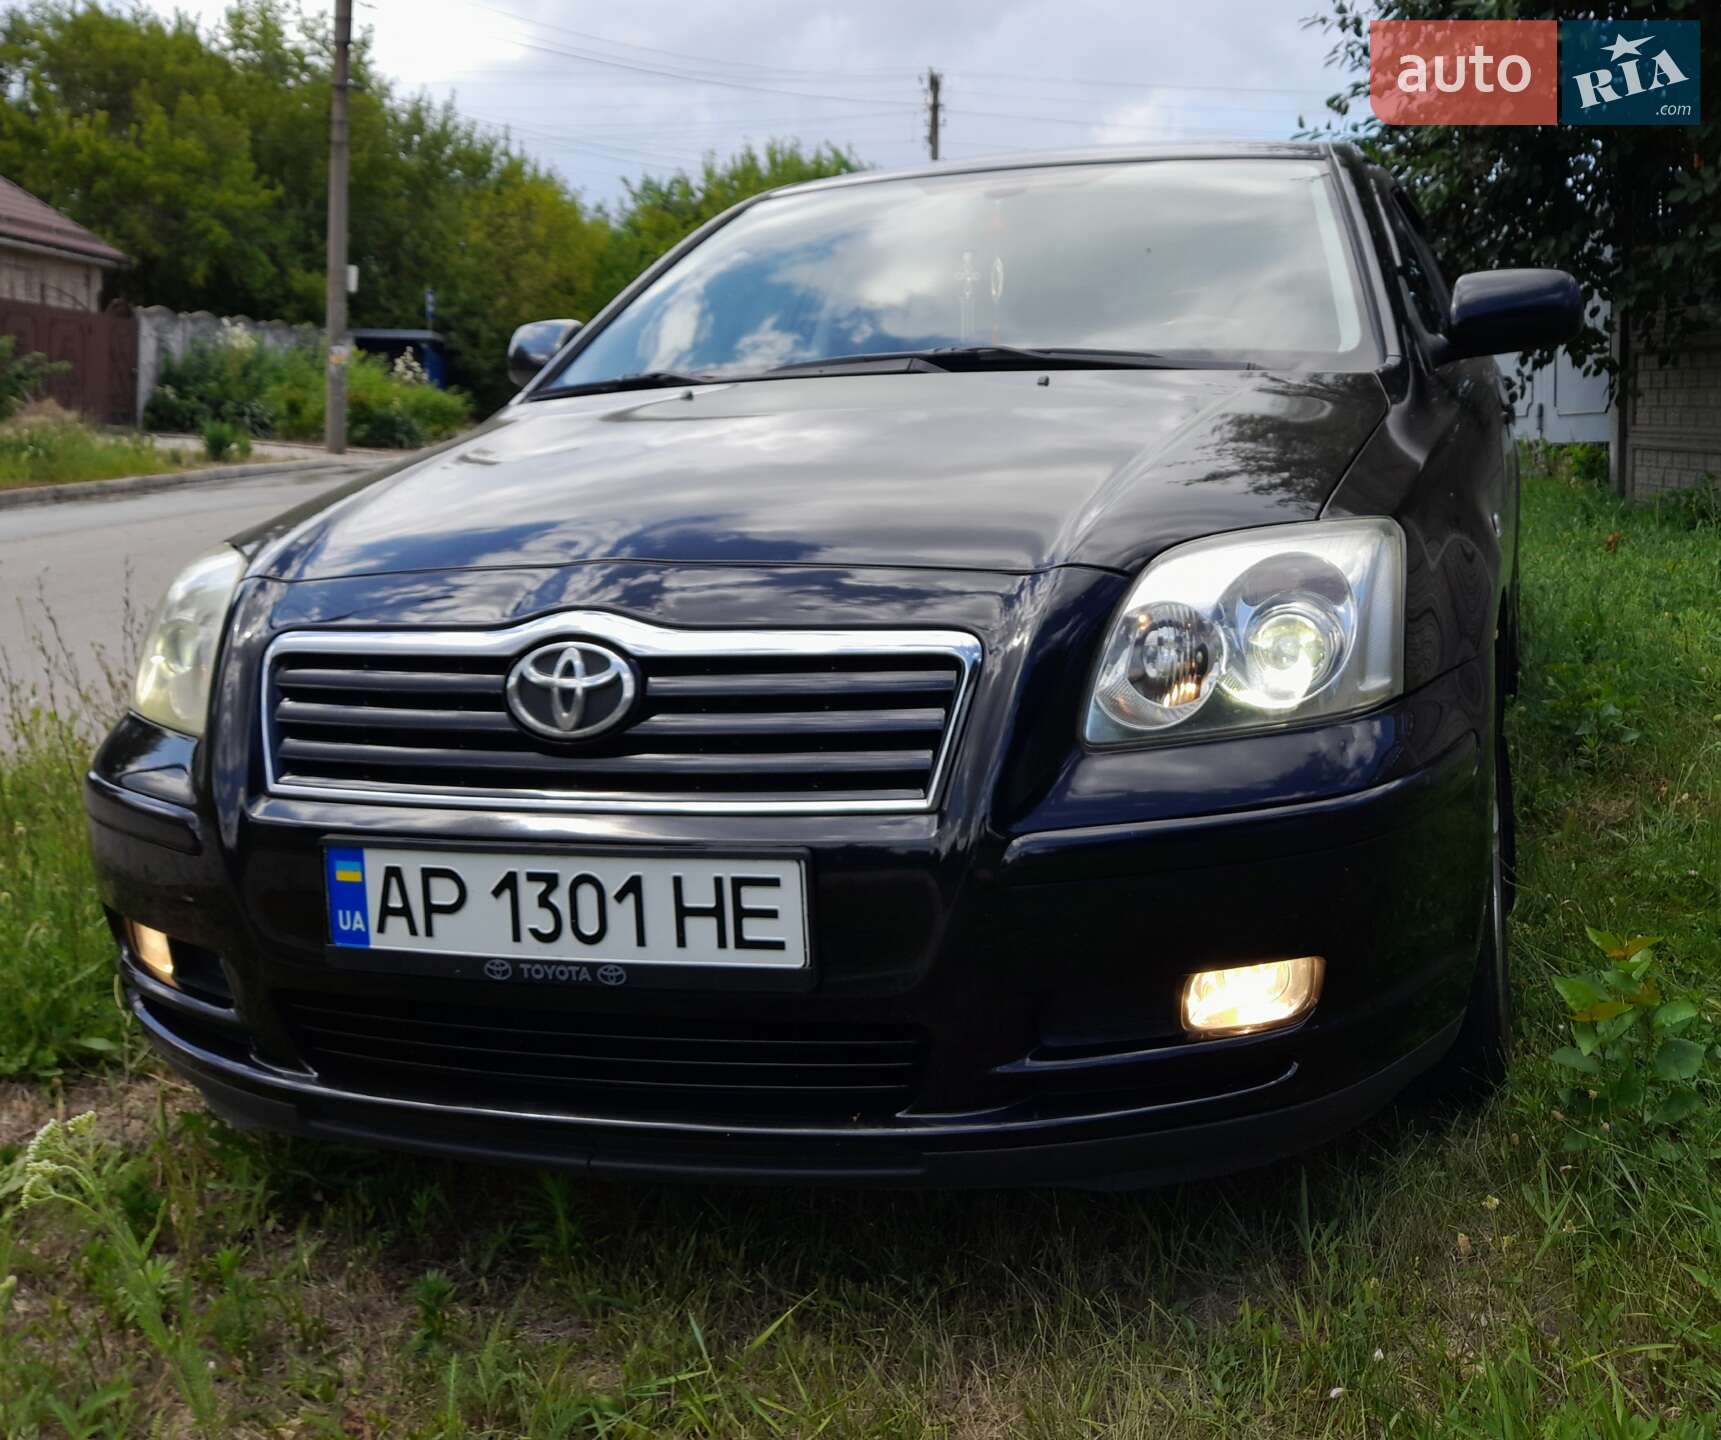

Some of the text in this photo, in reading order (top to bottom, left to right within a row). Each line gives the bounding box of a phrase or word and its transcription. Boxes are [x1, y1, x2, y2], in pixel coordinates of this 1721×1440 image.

[376, 865, 787, 951] AP 1301 HE
[338, 909, 366, 933] UA
[519, 963, 592, 982] TOYOTA
